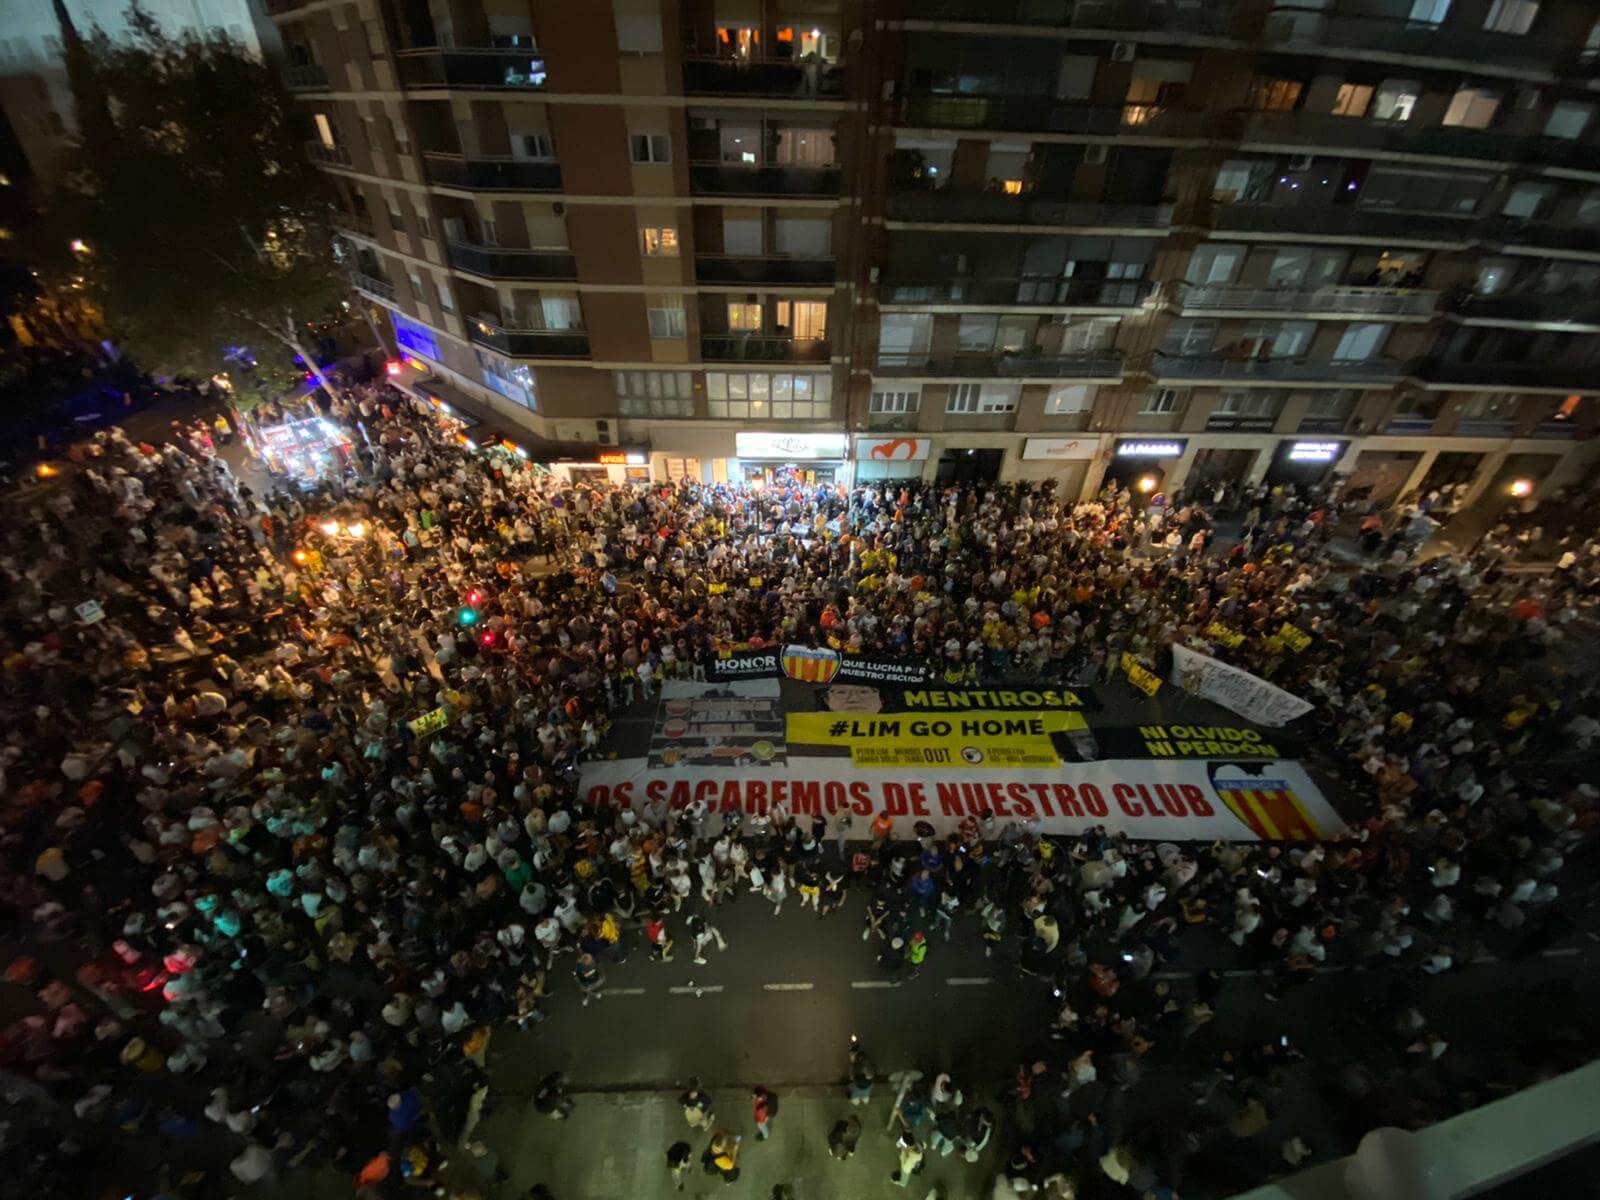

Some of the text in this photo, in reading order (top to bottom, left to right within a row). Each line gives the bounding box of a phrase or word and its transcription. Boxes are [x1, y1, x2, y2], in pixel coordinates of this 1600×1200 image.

[715, 655, 777, 671] HONOR
[842, 659, 926, 675] QUE LUCHA PR
[840, 668, 924, 683] NUESTRO ESCUDO
[903, 689, 1084, 708] MENTIROSA
[829, 719, 1045, 737] #LIM GO HOME
[1139, 725, 1262, 742] NI OLVIDO
[923, 747, 952, 763] OUT
[1145, 741, 1176, 756] NI
[588, 779, 1215, 817] OS SACAREMOS DE NUESTRO CLUB
